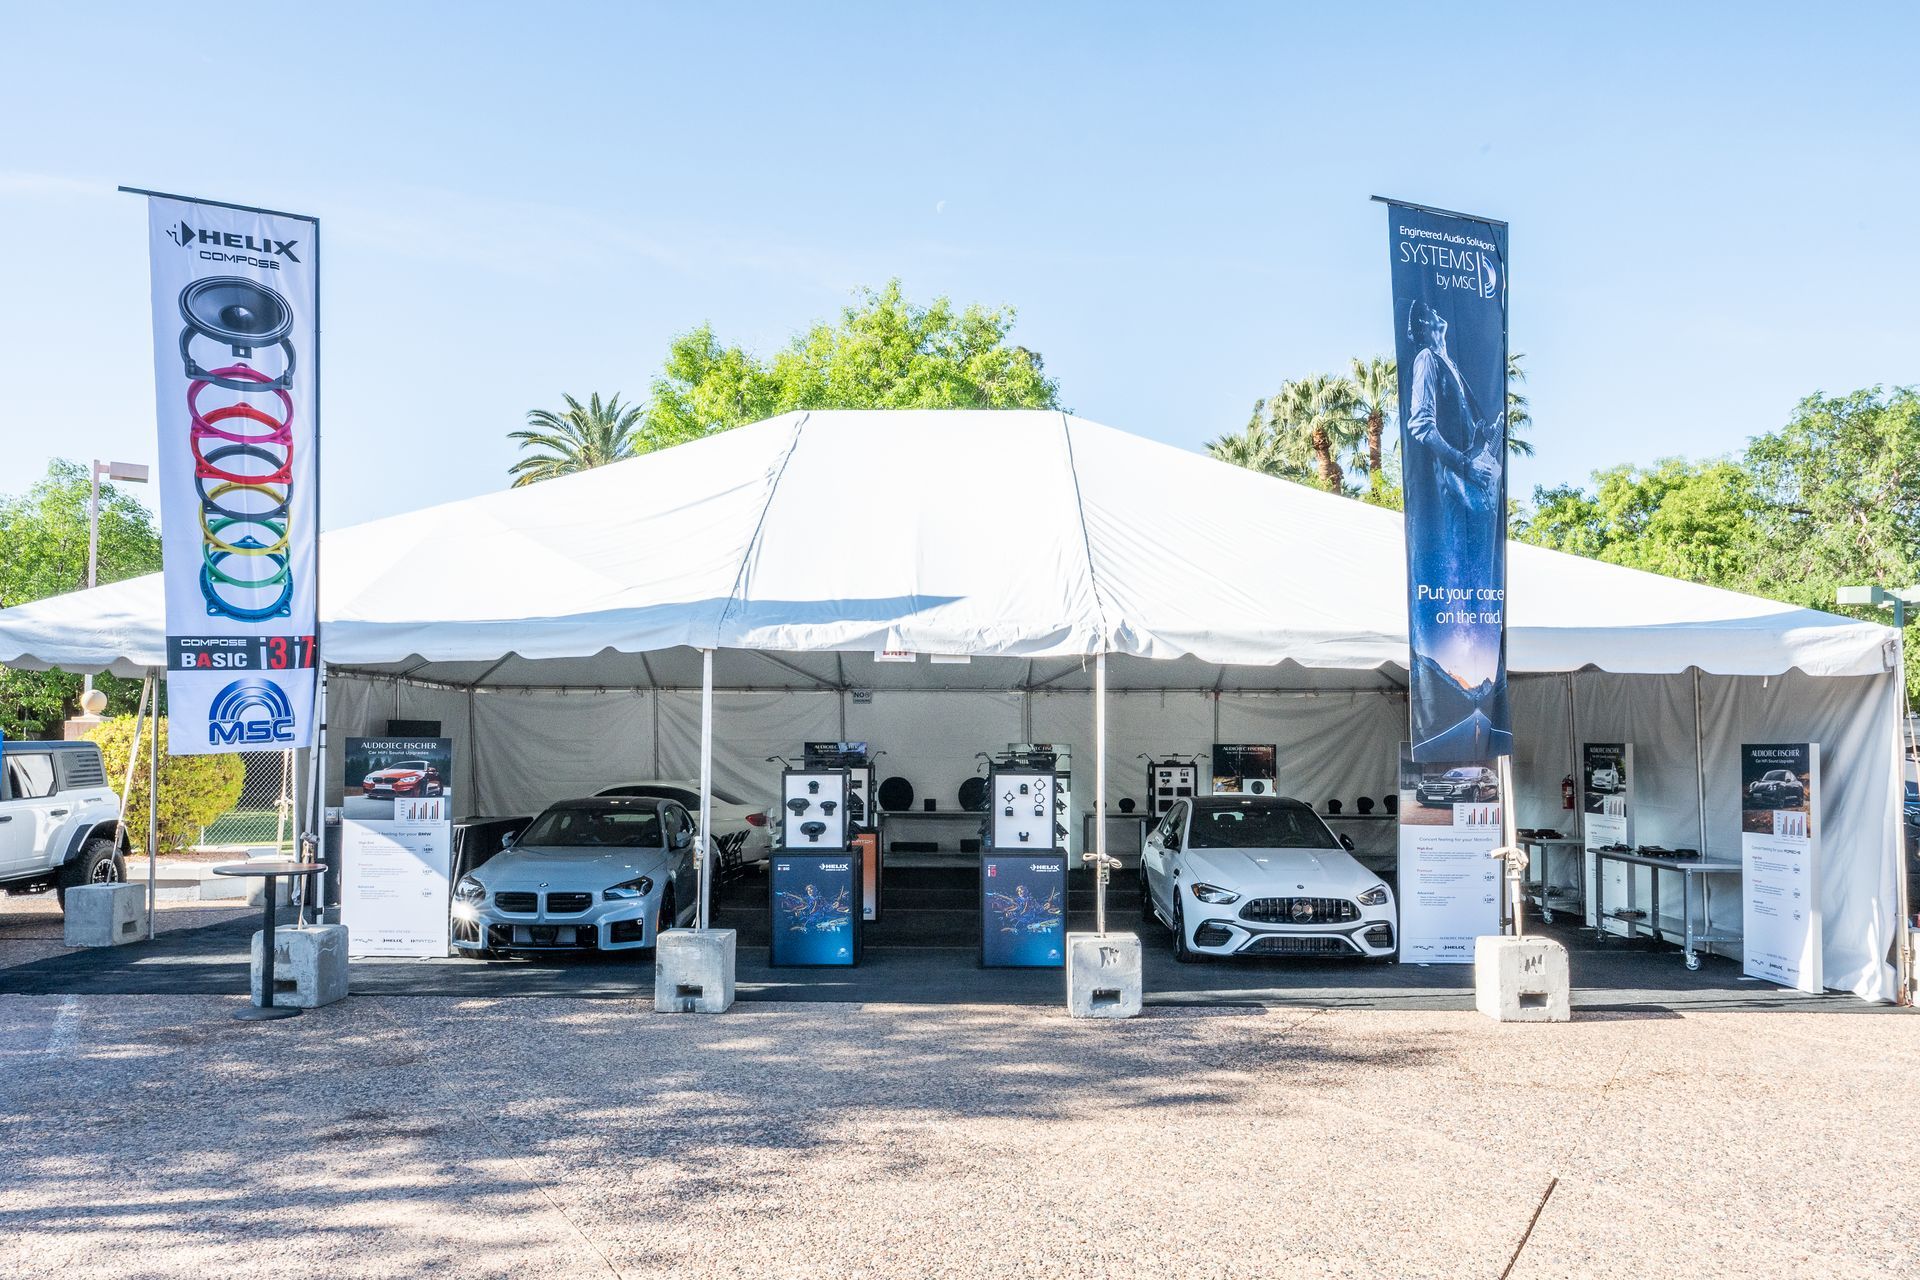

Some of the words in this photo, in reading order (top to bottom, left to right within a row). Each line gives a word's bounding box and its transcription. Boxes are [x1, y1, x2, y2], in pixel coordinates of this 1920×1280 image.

[1399, 225, 1443, 242] Engineered
[1443, 232, 1466, 245] Audio
[198, 229, 301, 263] HELIX
[199, 250, 281, 270] COMPOSE
[1400, 241, 1475, 272] SYSTEMS
[1436, 272, 1450, 290] by
[1452, 274, 1477, 291] MSC
[1418, 584, 1445, 600] Put
[1446, 588, 1474, 604] your
[1436, 611, 1455, 624] on
[1456, 609, 1477, 624] the
[180, 639, 247, 647] COMPOSE
[181, 652, 248, 668] BASIC
[209, 719, 295, 745] MSC
